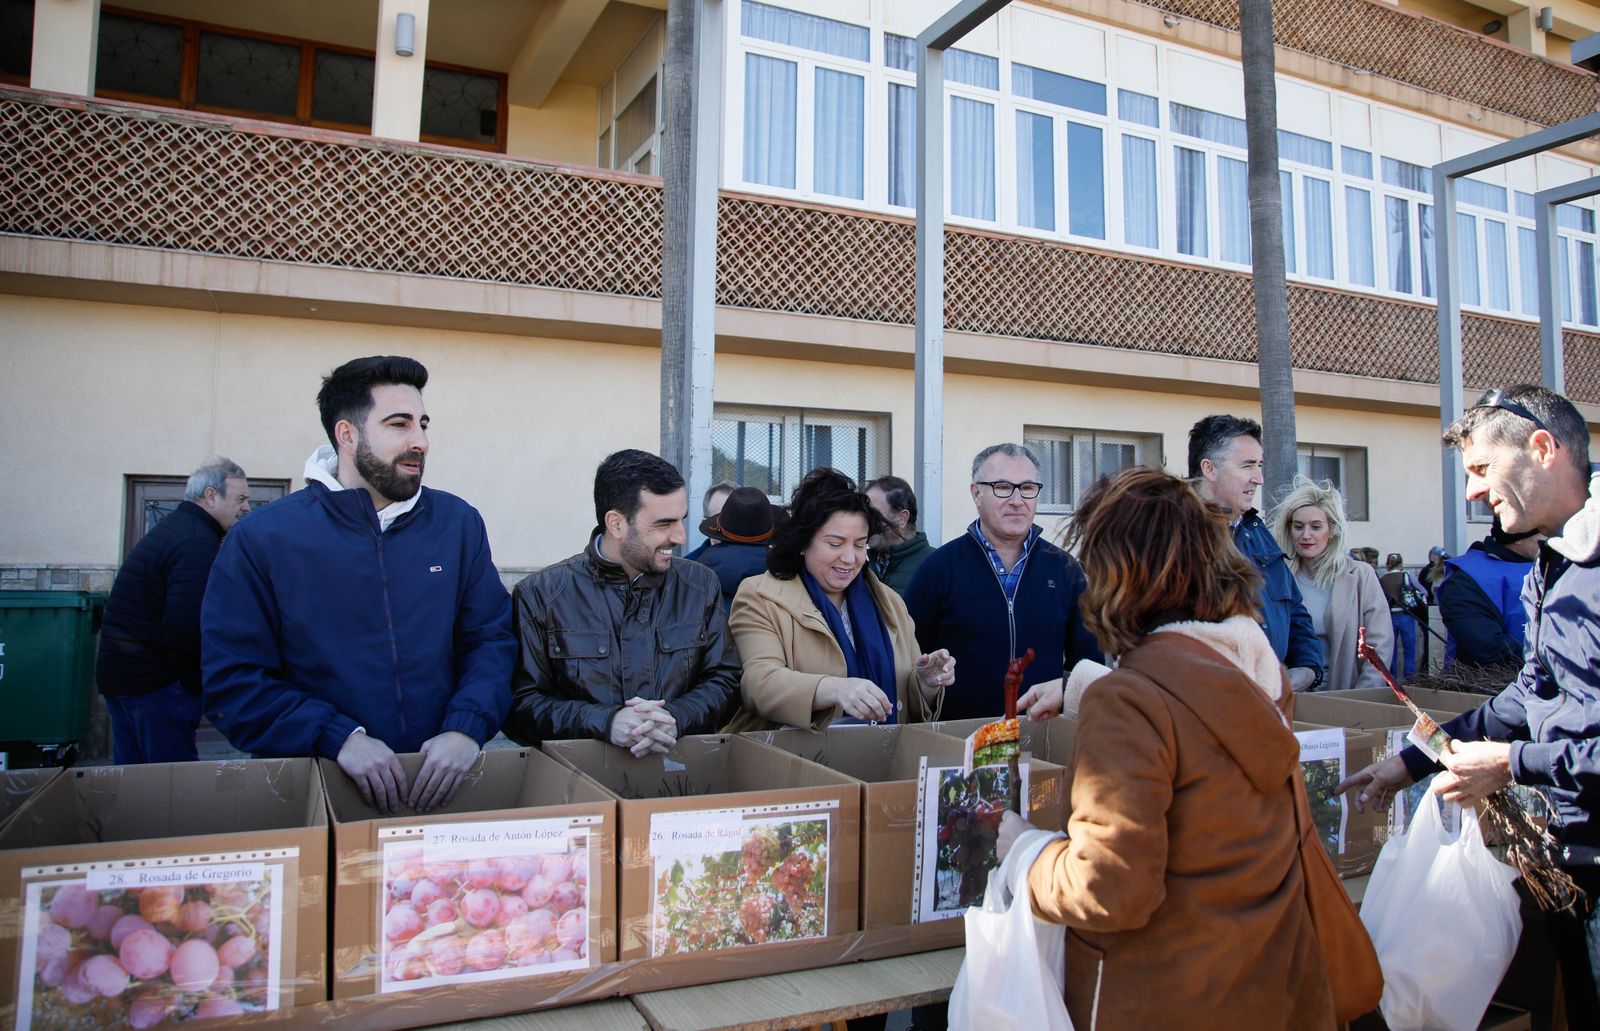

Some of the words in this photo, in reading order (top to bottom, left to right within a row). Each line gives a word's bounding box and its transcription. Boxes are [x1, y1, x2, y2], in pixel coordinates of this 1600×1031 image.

[451, 833, 486, 844] Rosada
[488, 832, 501, 842] de
[503, 830, 532, 841] Antón
[534, 828, 563, 840] López
[672, 830, 703, 840] Rosada
[704, 829, 716, 839] de
[139, 870, 182, 884] Rosada
[185, 867, 199, 880] de
[202, 866, 253, 880] Gregorio
